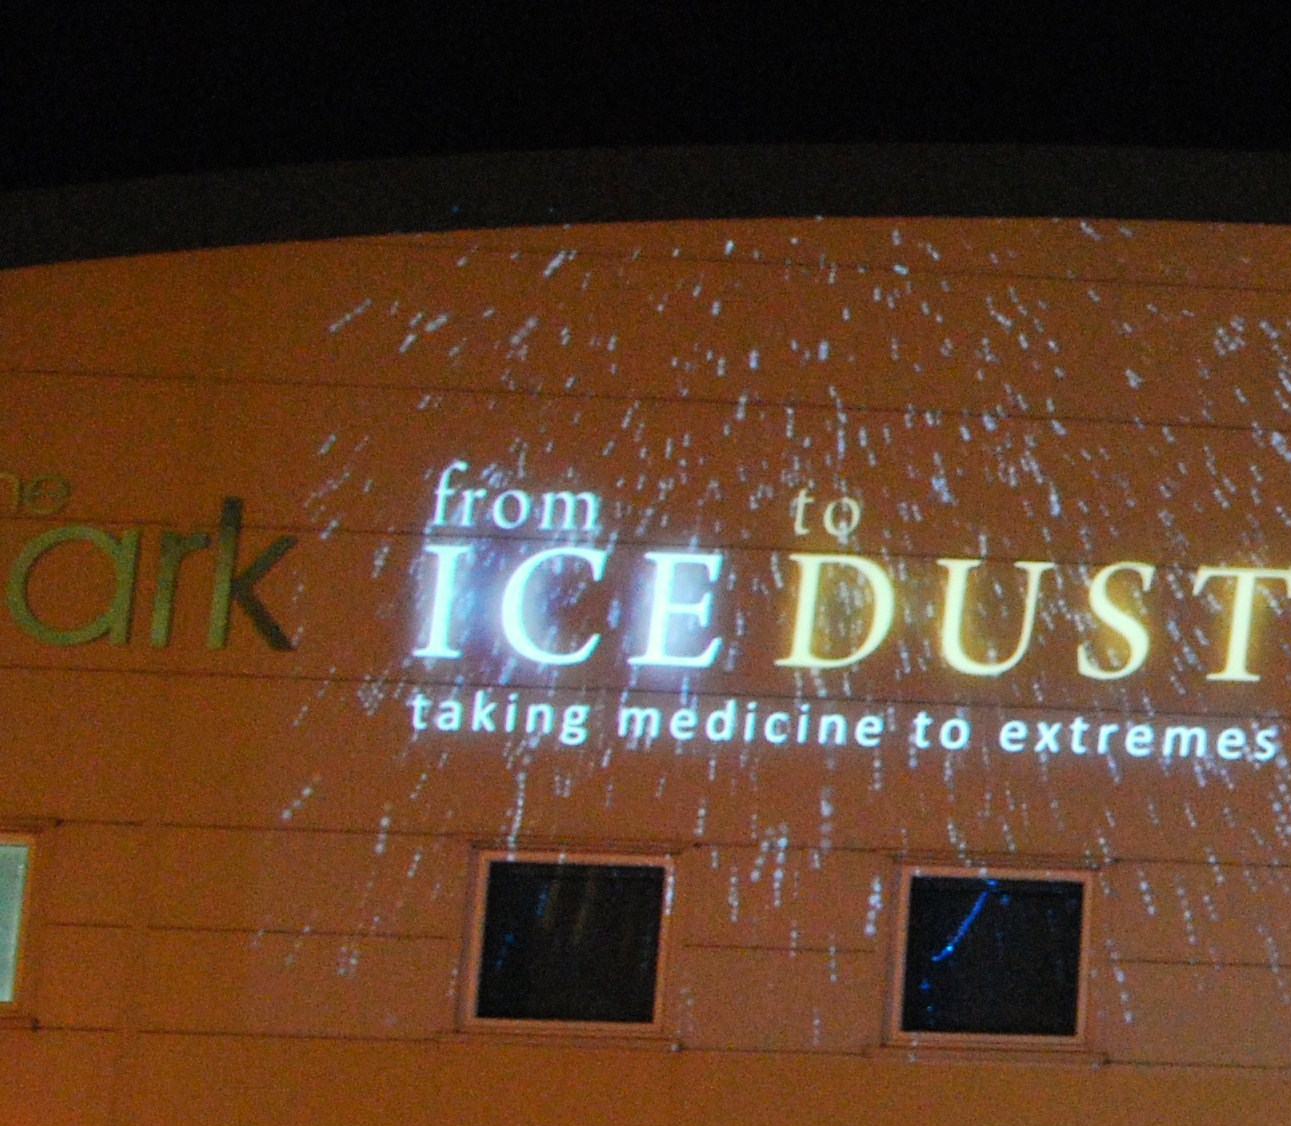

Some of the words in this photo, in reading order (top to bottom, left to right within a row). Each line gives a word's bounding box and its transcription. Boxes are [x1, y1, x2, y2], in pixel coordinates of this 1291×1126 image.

[431, 459, 602, 531] from
[792, 488, 861, 537] to
[7, 496, 297, 650] ark
[412, 544, 724, 667] ICE
[411, 690, 591, 745] taking
[617, 698, 884, 747] medicine
[913, 711, 971, 750] to
[999, 716, 1280, 761] extremes
